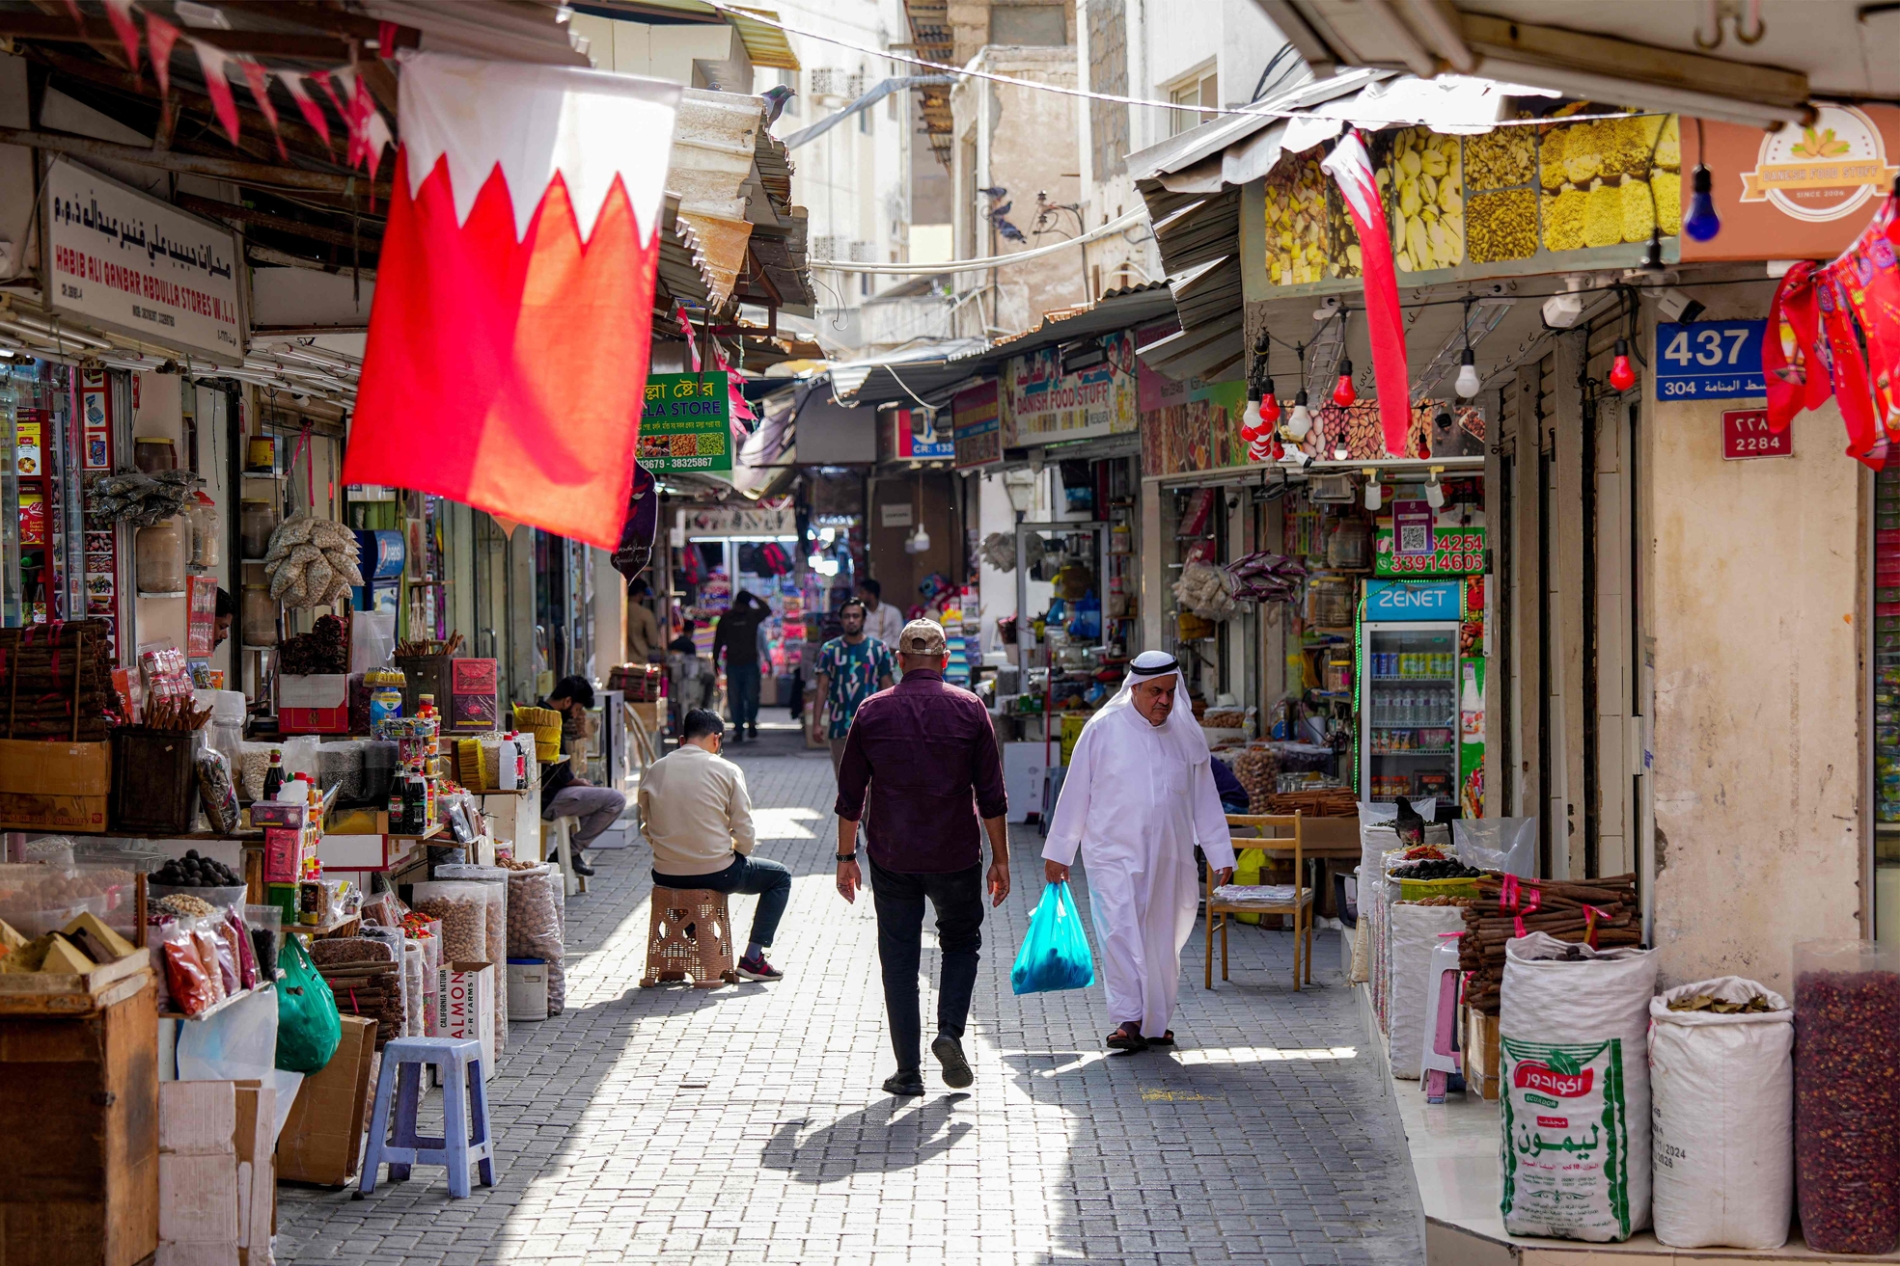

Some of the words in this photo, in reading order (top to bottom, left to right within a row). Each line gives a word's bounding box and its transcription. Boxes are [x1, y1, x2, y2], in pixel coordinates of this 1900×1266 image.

[1809, 167, 1838, 180] FOOD
[1842, 165, 1879, 178] STUFF
[1796, 191, 1821, 199] SINCE
[147, 224, 166, 267] علي
[56, 244, 86, 278] HABIB
[88, 255, 102, 284] ALI
[104, 261, 141, 296] QANBAR
[143, 274, 180, 308] ABDULLA
[181, 286, 212, 318] STORES
[1664, 329, 1750, 367] 437
[1664, 382, 1697, 395] 304
[1705, 380, 1740, 392] المنامة
[1017, 391, 1048, 415] DANISH
[1050, 387, 1075, 410] FOOD
[1077, 381, 1107, 406] STUFF
[671, 401, 722, 417] STORE
[1735, 418, 1768, 432] ٢٢٨
[1736, 437, 1780, 451] 2284
[671, 457, 713, 469] 38325867
[1391, 554, 1484, 573] 33914606
[1379, 590, 1447, 607] ZENET
[54, 816, 90, 826] QUALITY
[467, 981, 475, 1014] FARMS
[439, 993, 448, 1029] CALIFORNIA
[1525, 1072, 1582, 1095] اكوادور
[1526, 1094, 1557, 1107] ECUADOR
[1517, 1122, 1600, 1161] ليمون
